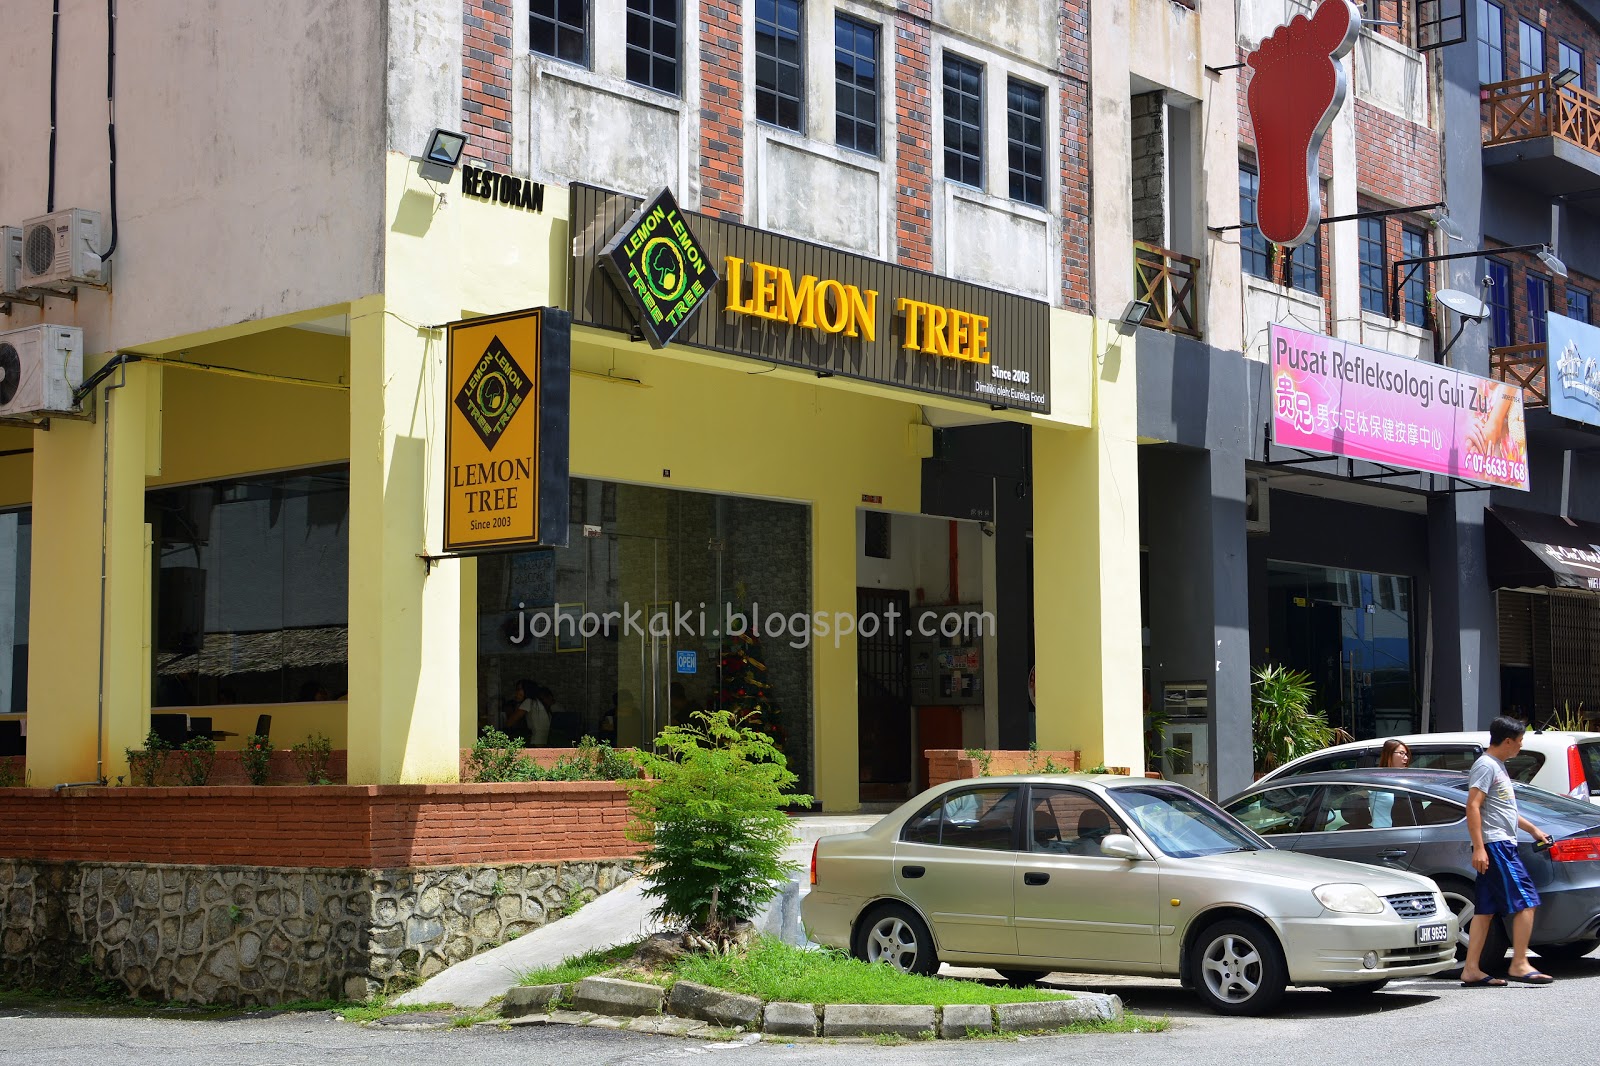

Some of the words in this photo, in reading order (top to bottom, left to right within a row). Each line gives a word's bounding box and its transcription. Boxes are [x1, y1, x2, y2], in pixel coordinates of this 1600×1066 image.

[462, 164, 544, 212] RESTORAN
[624, 205, 665, 259] LEMON
[666, 209, 706, 276] LEMON
[627, 262, 664, 326] TREE
[665, 279, 705, 329] TREE
[723, 256, 879, 342] LEMON
[898, 298, 990, 364] TREE
[464, 351, 494, 397] LEMON
[494, 350, 523, 390] LEMON
[991, 364, 1011, 380] Since
[1012, 369, 1030, 384] 2003
[1276, 337, 1328, 377] Pusat
[1332, 351, 1434, 408] Refleksologi
[1438, 378, 1465, 409] Gui
[1468, 386, 1488, 414] Zu
[975, 381, 997, 395] Dimiliki
[1010, 387, 1031, 402] Eureka
[1030, 391, 1045, 404] Food
[467, 399, 492, 436] TREE
[493, 393, 523, 433] TREE
[1316, 403, 1443, 451] 男女足体保健按摩中心
[453, 457, 532, 488] LEMON
[1472, 453, 1508, 478] 07-6633
[1508, 461, 1525, 481] 768
[465, 487, 518, 514] TREE
[470, 518, 491, 531] Since
[492, 516, 512, 528] 2003
[678, 656, 695, 668] OPEN
[1420, 927, 1431, 941] JHK
[1431, 926, 1447, 940] 9655
